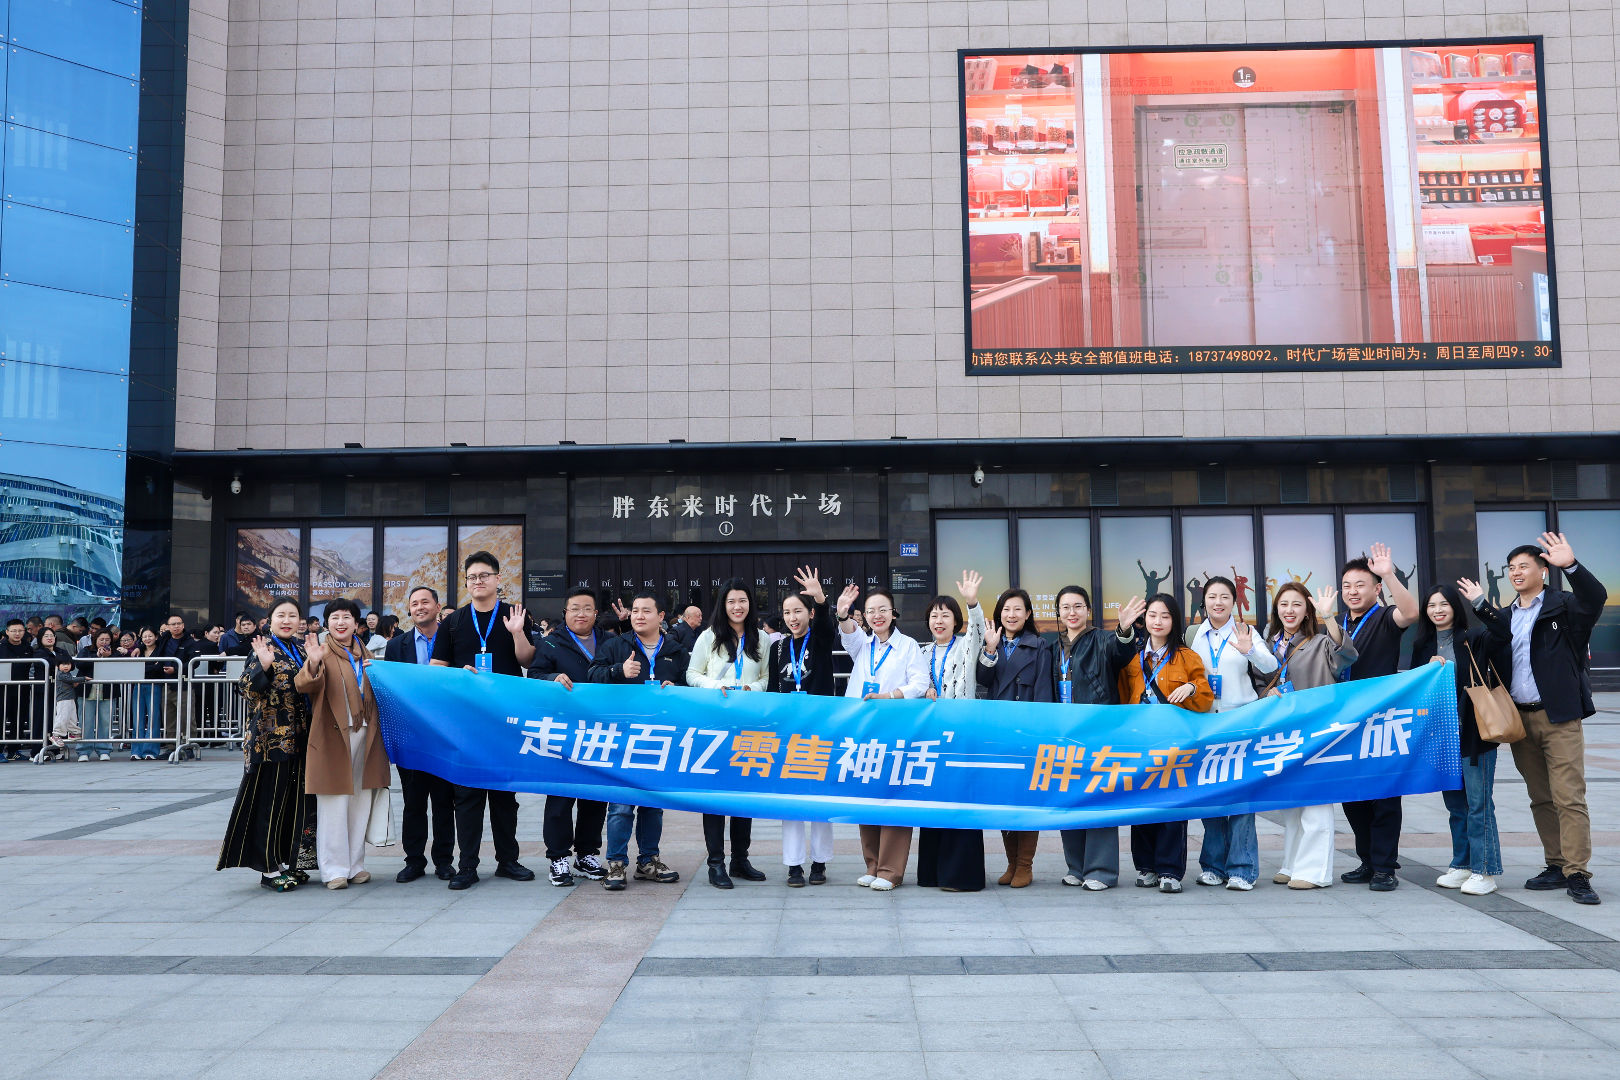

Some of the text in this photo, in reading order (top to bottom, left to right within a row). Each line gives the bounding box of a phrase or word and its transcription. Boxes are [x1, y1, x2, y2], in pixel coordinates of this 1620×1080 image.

[612, 492, 842, 519] 胖东来时代广场
[384, 580, 406, 588] FIRST
